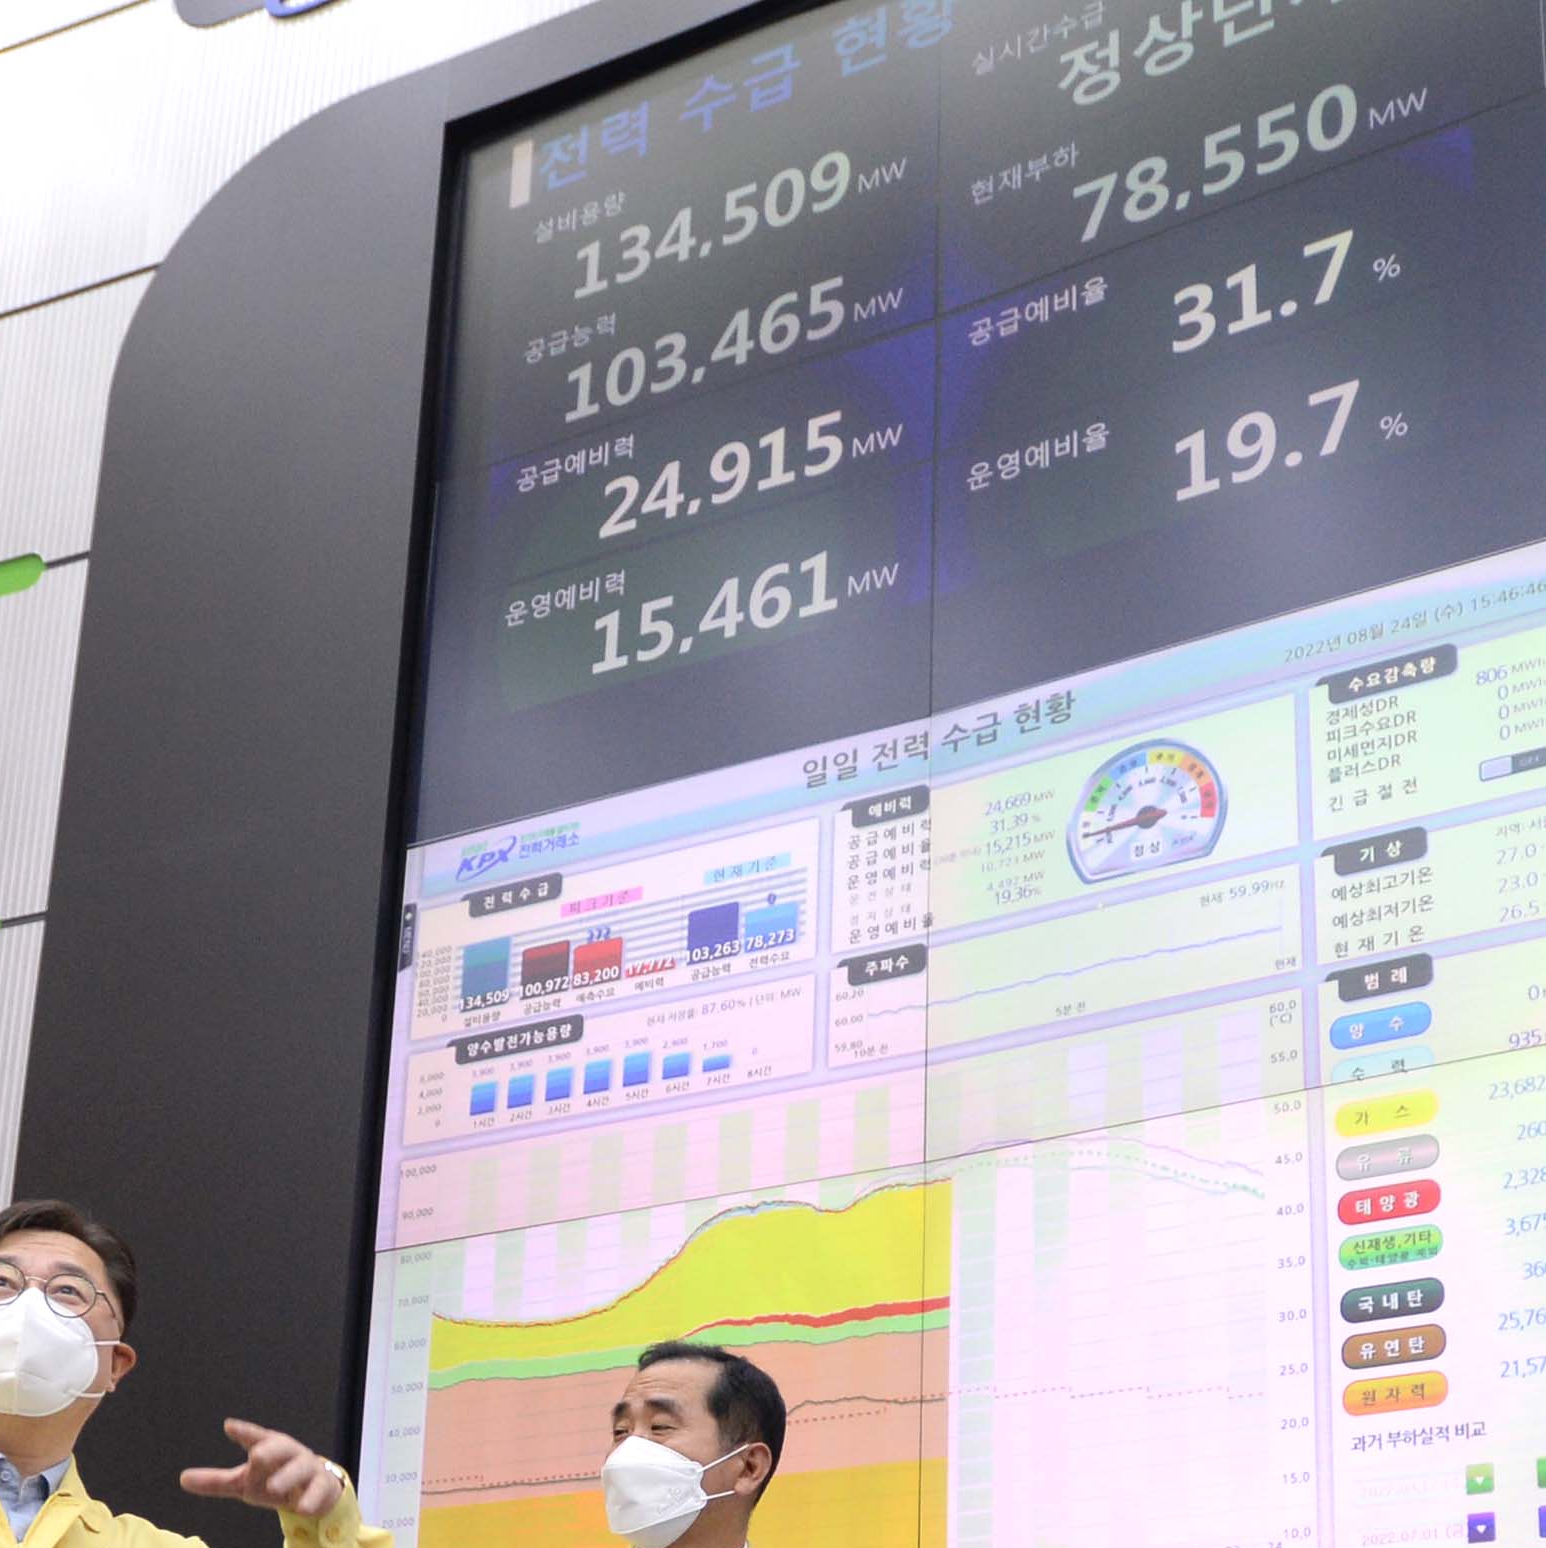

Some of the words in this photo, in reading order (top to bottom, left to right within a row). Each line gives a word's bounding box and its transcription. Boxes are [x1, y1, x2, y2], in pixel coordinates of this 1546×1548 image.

[539, 101, 649, 191] 전력
[680, 43, 800, 133] 수급
[970, 143, 1079, 205] 현재부하
[1073, 84, 1357, 243] 78,550
[1368, 87, 1428, 130] MW
[535, 190, 625, 243] 설비용량
[574, 151, 851, 299] 134,509
[858, 157, 907, 192] MW
[968, 275, 1108, 346] 공급예비율
[1172, 229, 1354, 354] 31.7
[1373, 254, 1401, 280] %
[525, 312, 616, 364] 공급능력
[565, 277, 844, 423] 103,465
[854, 288, 904, 322] MW
[516, 433, 634, 492] 공급예비력
[966, 422, 1110, 491] 운영예비율
[1174, 379, 1360, 502] 19.7
[1380, 412, 1409, 440] %
[599, 410, 843, 539] 24,915
[853, 424, 903, 458] MW
[504, 569, 625, 628] 운영예비력
[591, 551, 838, 675] 15,461
[847, 563, 899, 597] MW
[1284, 633, 1342, 663] 2022년
[1346, 621, 1384, 647] 08월
[1390, 610, 1428, 635] 24일
[1433, 602, 1464, 624] (수)
[1327, 695, 1399, 725] 경제성DR
[1476, 665, 1508, 685] 806
[1349, 656, 1436, 692] 수요감축량
[802, 747, 859, 789] 일일
[870, 730, 930, 772] 전력
[940, 712, 1002, 754] 수급
[1013, 690, 1076, 735] 현황
[1327, 710, 1417, 743] 피크수요DR
[1498, 685, 1509, 700] 0
[1327, 731, 1418, 761] 미세먼지DR
[1498, 705, 1510, 720] 0
[1329, 754, 1401, 784] 플러스DR
[1499, 724, 1511, 740] 0
[868, 796, 911, 817] 예비력
[1033, 790, 1055, 801] MW
[457, 842, 515, 877] KPX
[1034, 830, 1056, 843] MW
[1331, 866, 1433, 901] 예상최고기온
[1333, 895, 1434, 929] 예상최저기온
[458, 989, 510, 1010] 134,509
[518, 976, 570, 996] 100,972
[572, 965, 620, 986] 83,200
[686, 940, 740, 961] 103,263
[745, 929, 796, 950] 78,273
[865, 955, 909, 976] 주파수
[1528, 985, 1539, 1000] 0
[467, 1024, 573, 1057] 양수발전가능용량
[1509, 1029, 1542, 1048] 935
[1488, 1075, 1546, 1100] 23,682
[1351, 1429, 1383, 1452] 과거
[1387, 1425, 1450, 1448] 부하실적
[1454, 1421, 1486, 1440] 비교
